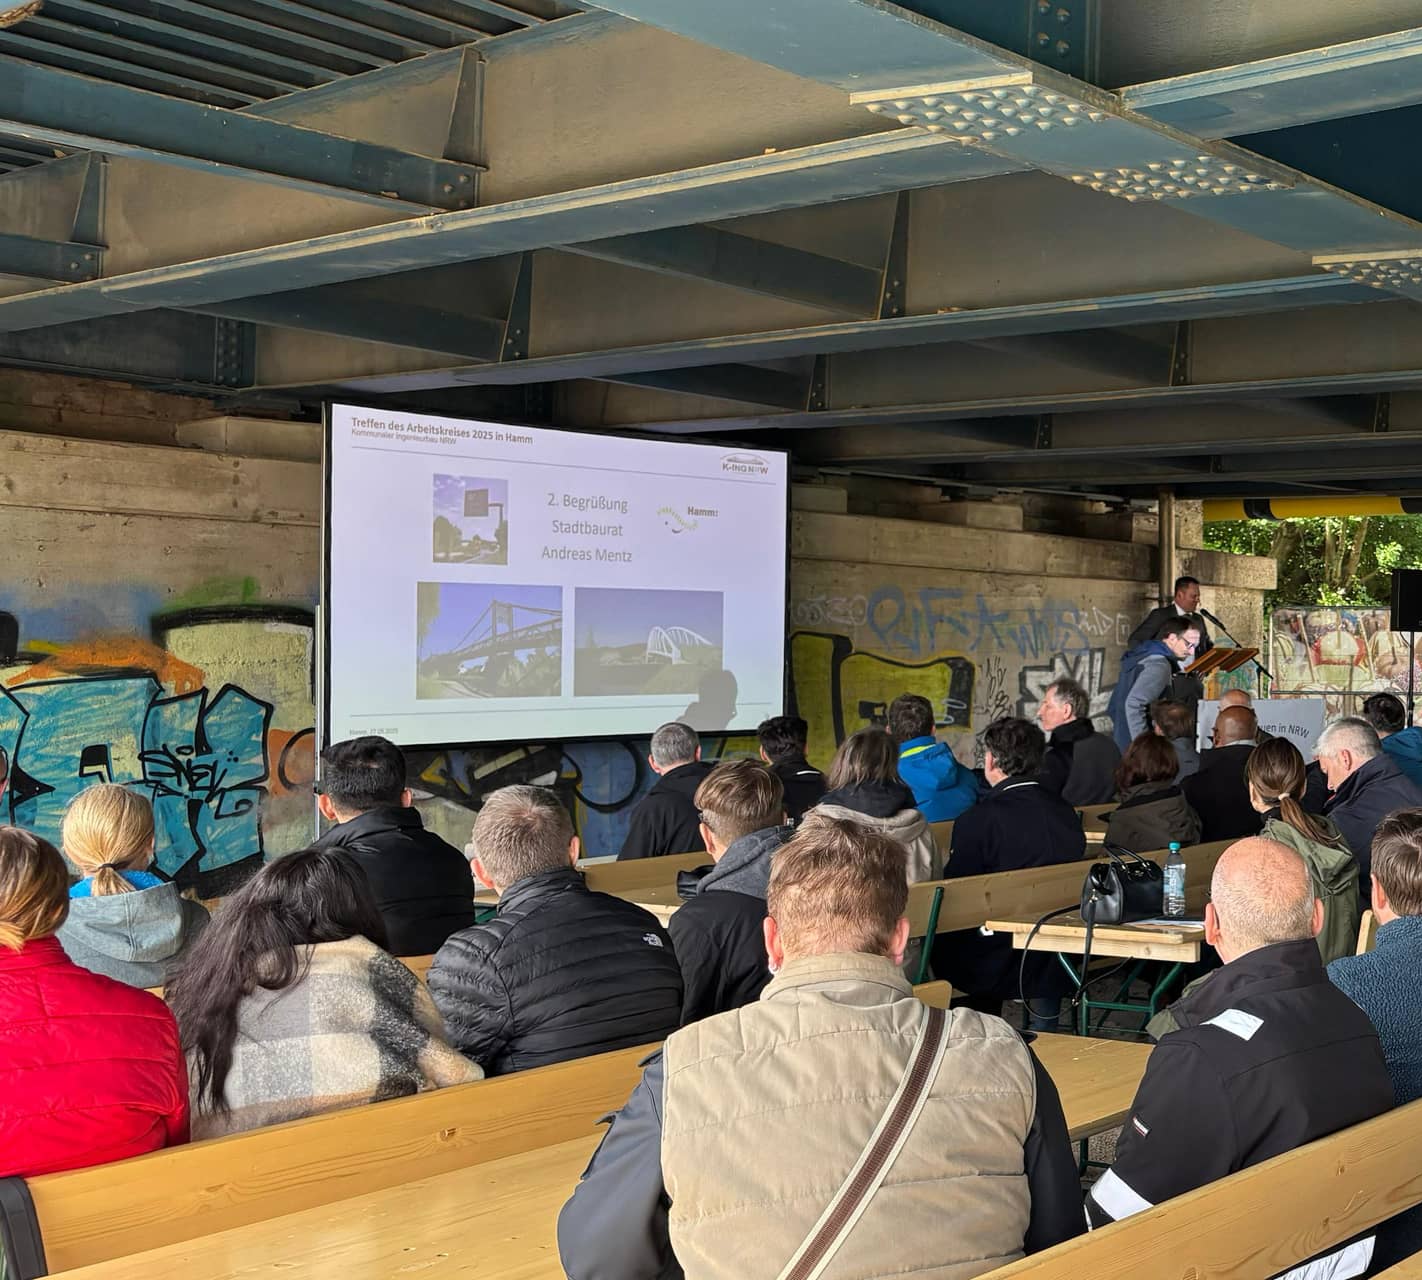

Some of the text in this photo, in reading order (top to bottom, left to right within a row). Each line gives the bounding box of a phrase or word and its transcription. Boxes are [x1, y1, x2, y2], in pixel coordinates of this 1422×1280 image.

[351, 417, 533, 445] Treffen des Arbeitskreises 2025 in Hamm
[547, 493, 629, 514] 2. Begrüßung
[687, 506, 719, 518] Hamm:
[552, 519, 624, 537] Stadtbaurat
[541, 545, 633, 563] Andreas Mentz
[1278, 723, 1287, 733] in
[1287, 725, 1310, 739] NRW
